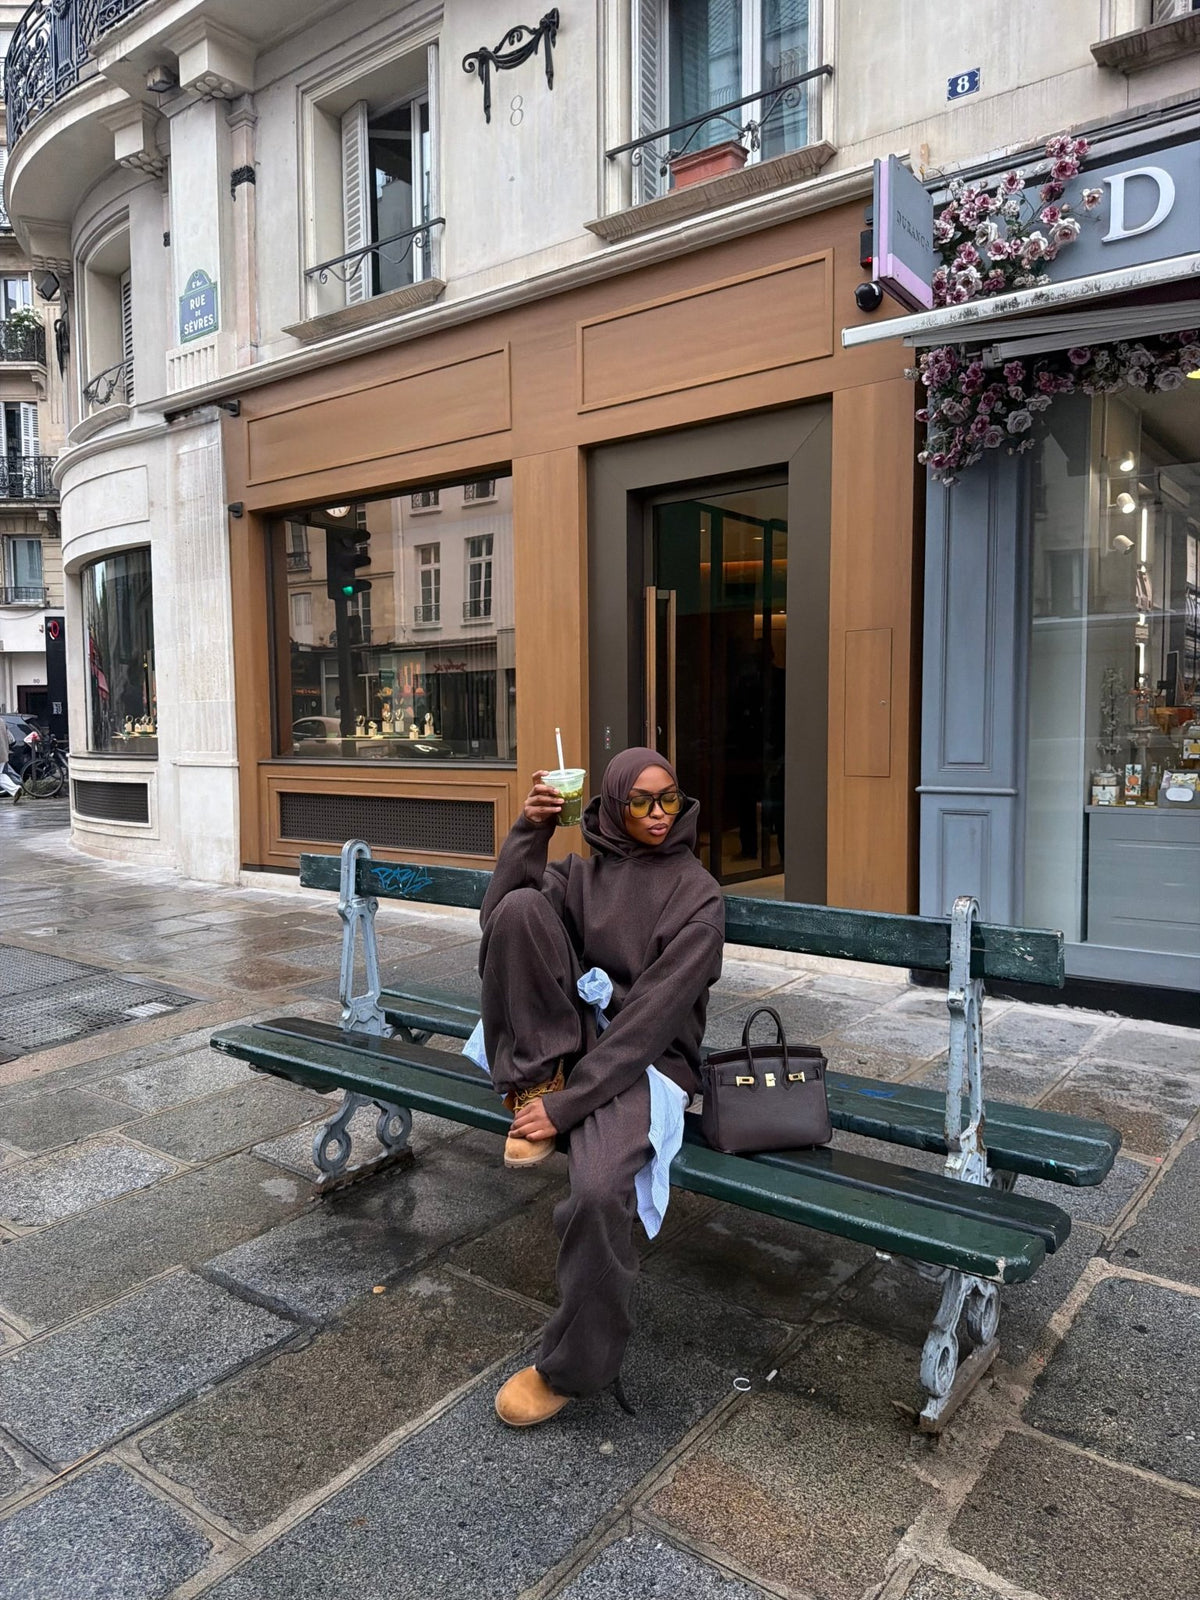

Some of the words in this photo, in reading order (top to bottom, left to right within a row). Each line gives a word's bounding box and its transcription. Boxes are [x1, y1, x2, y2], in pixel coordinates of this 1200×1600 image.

[957, 75, 970, 93] 8
[510, 95, 523, 126] 8
[1101, 166, 1175, 242] D
[190, 294, 206, 310] RUE
[184, 314, 213, 335] SÈVRES
